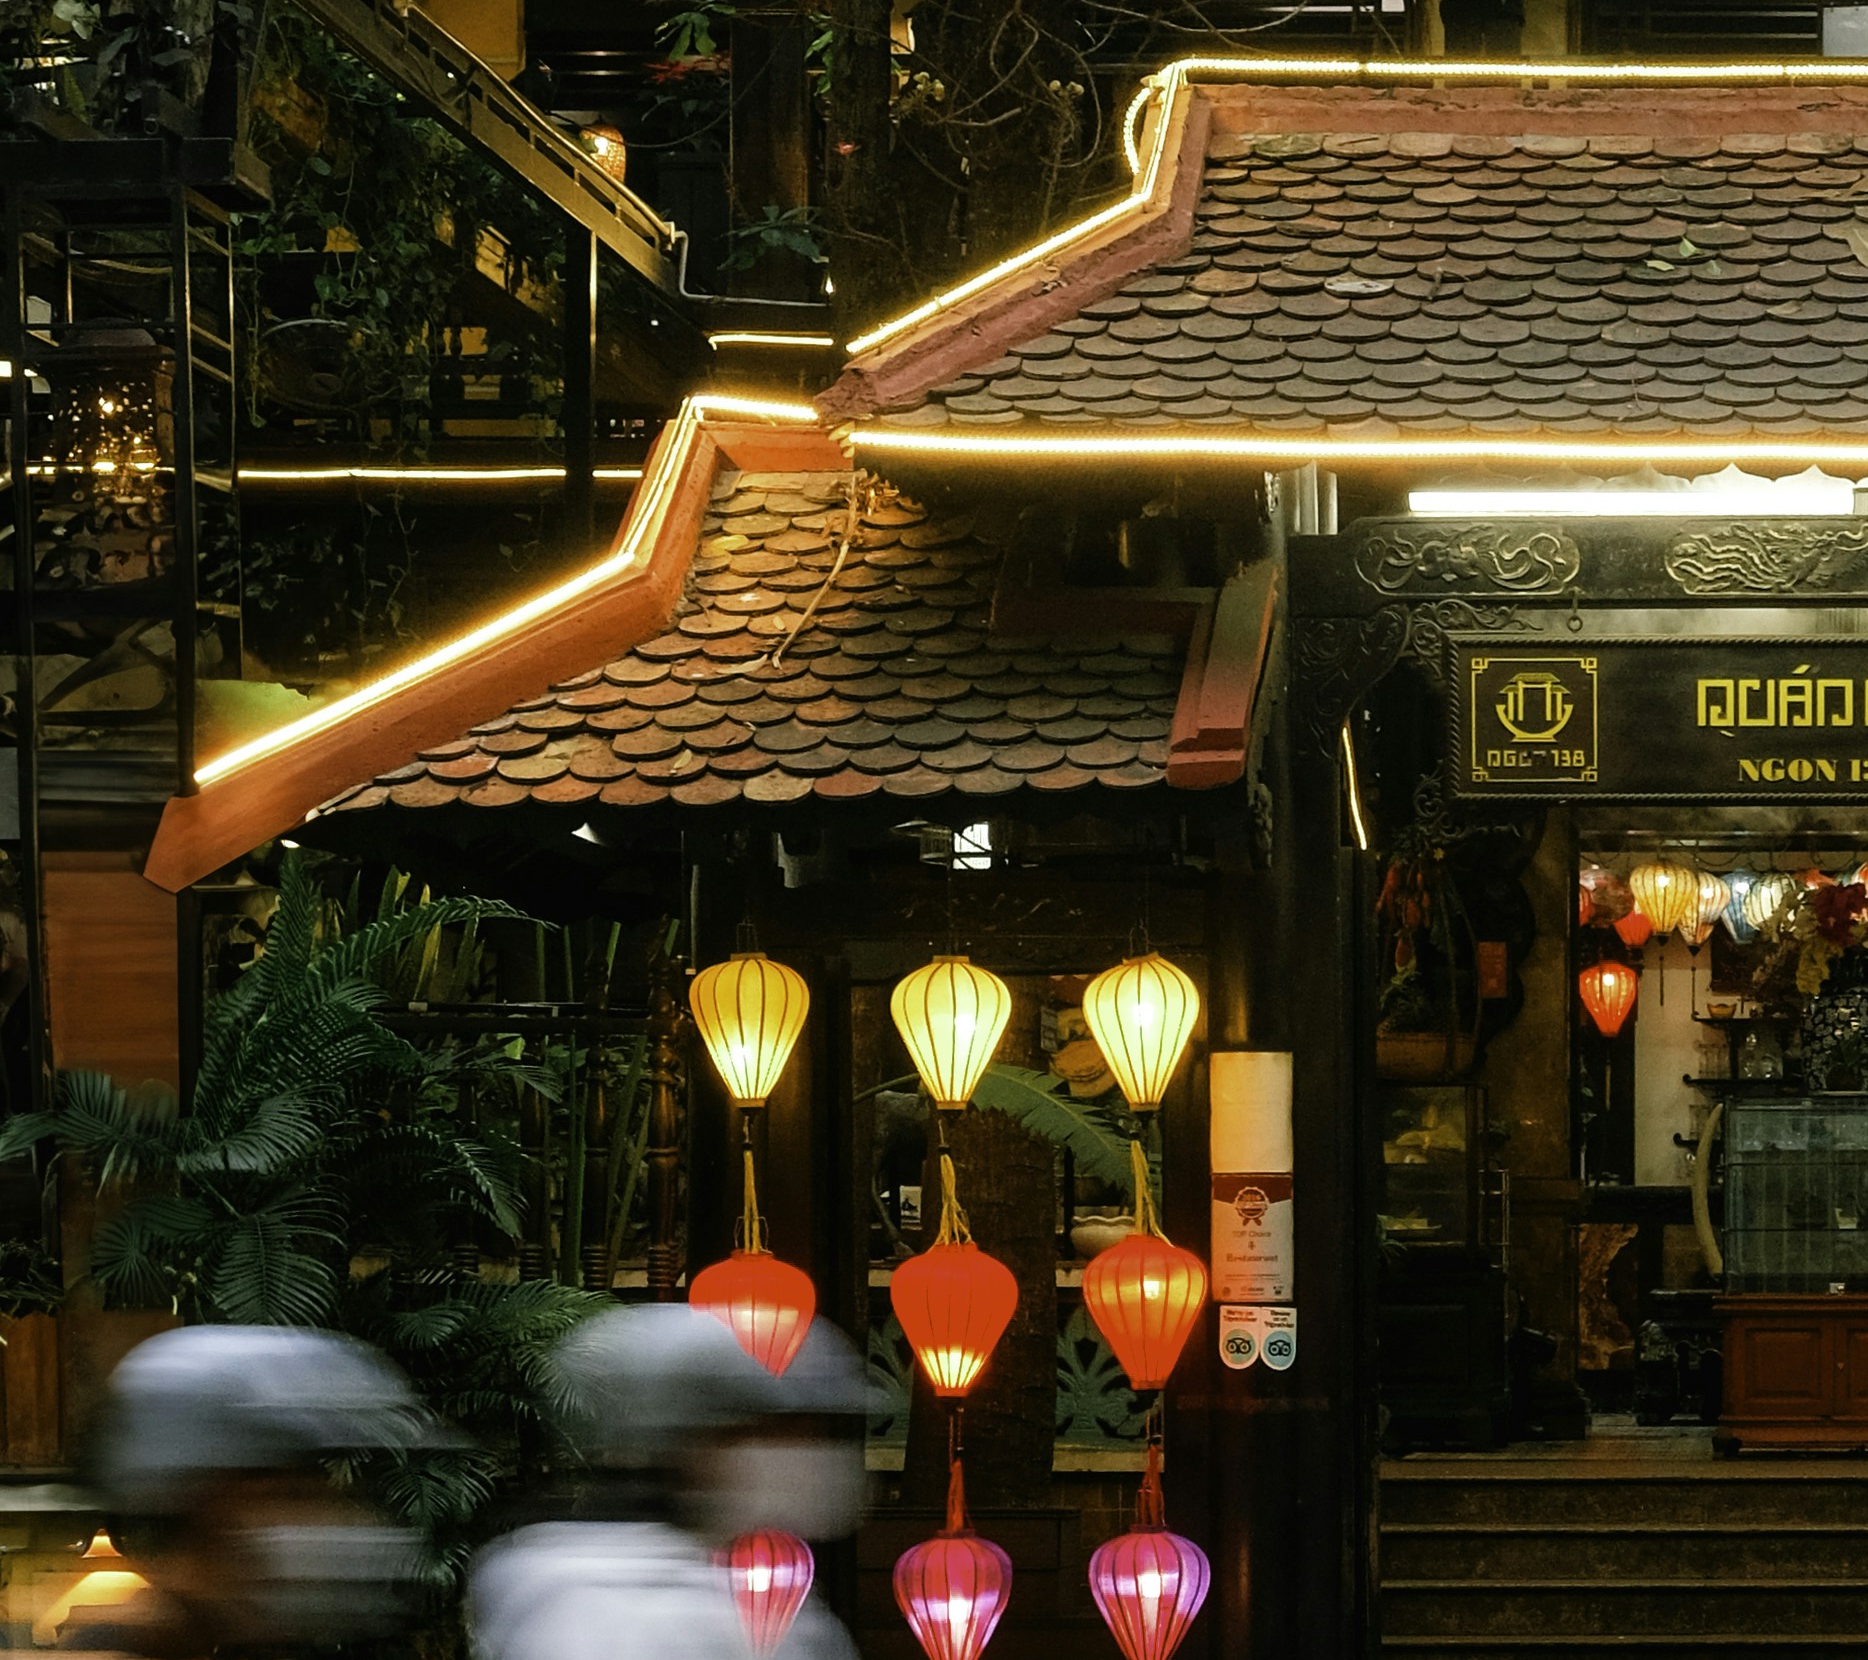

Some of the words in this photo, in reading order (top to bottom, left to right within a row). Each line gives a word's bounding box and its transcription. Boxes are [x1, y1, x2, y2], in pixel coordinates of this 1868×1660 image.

[1697, 664, 1854, 729] QUÁN
[1551, 749, 1586, 767] 138
[1737, 757, 1838, 783] NGON
